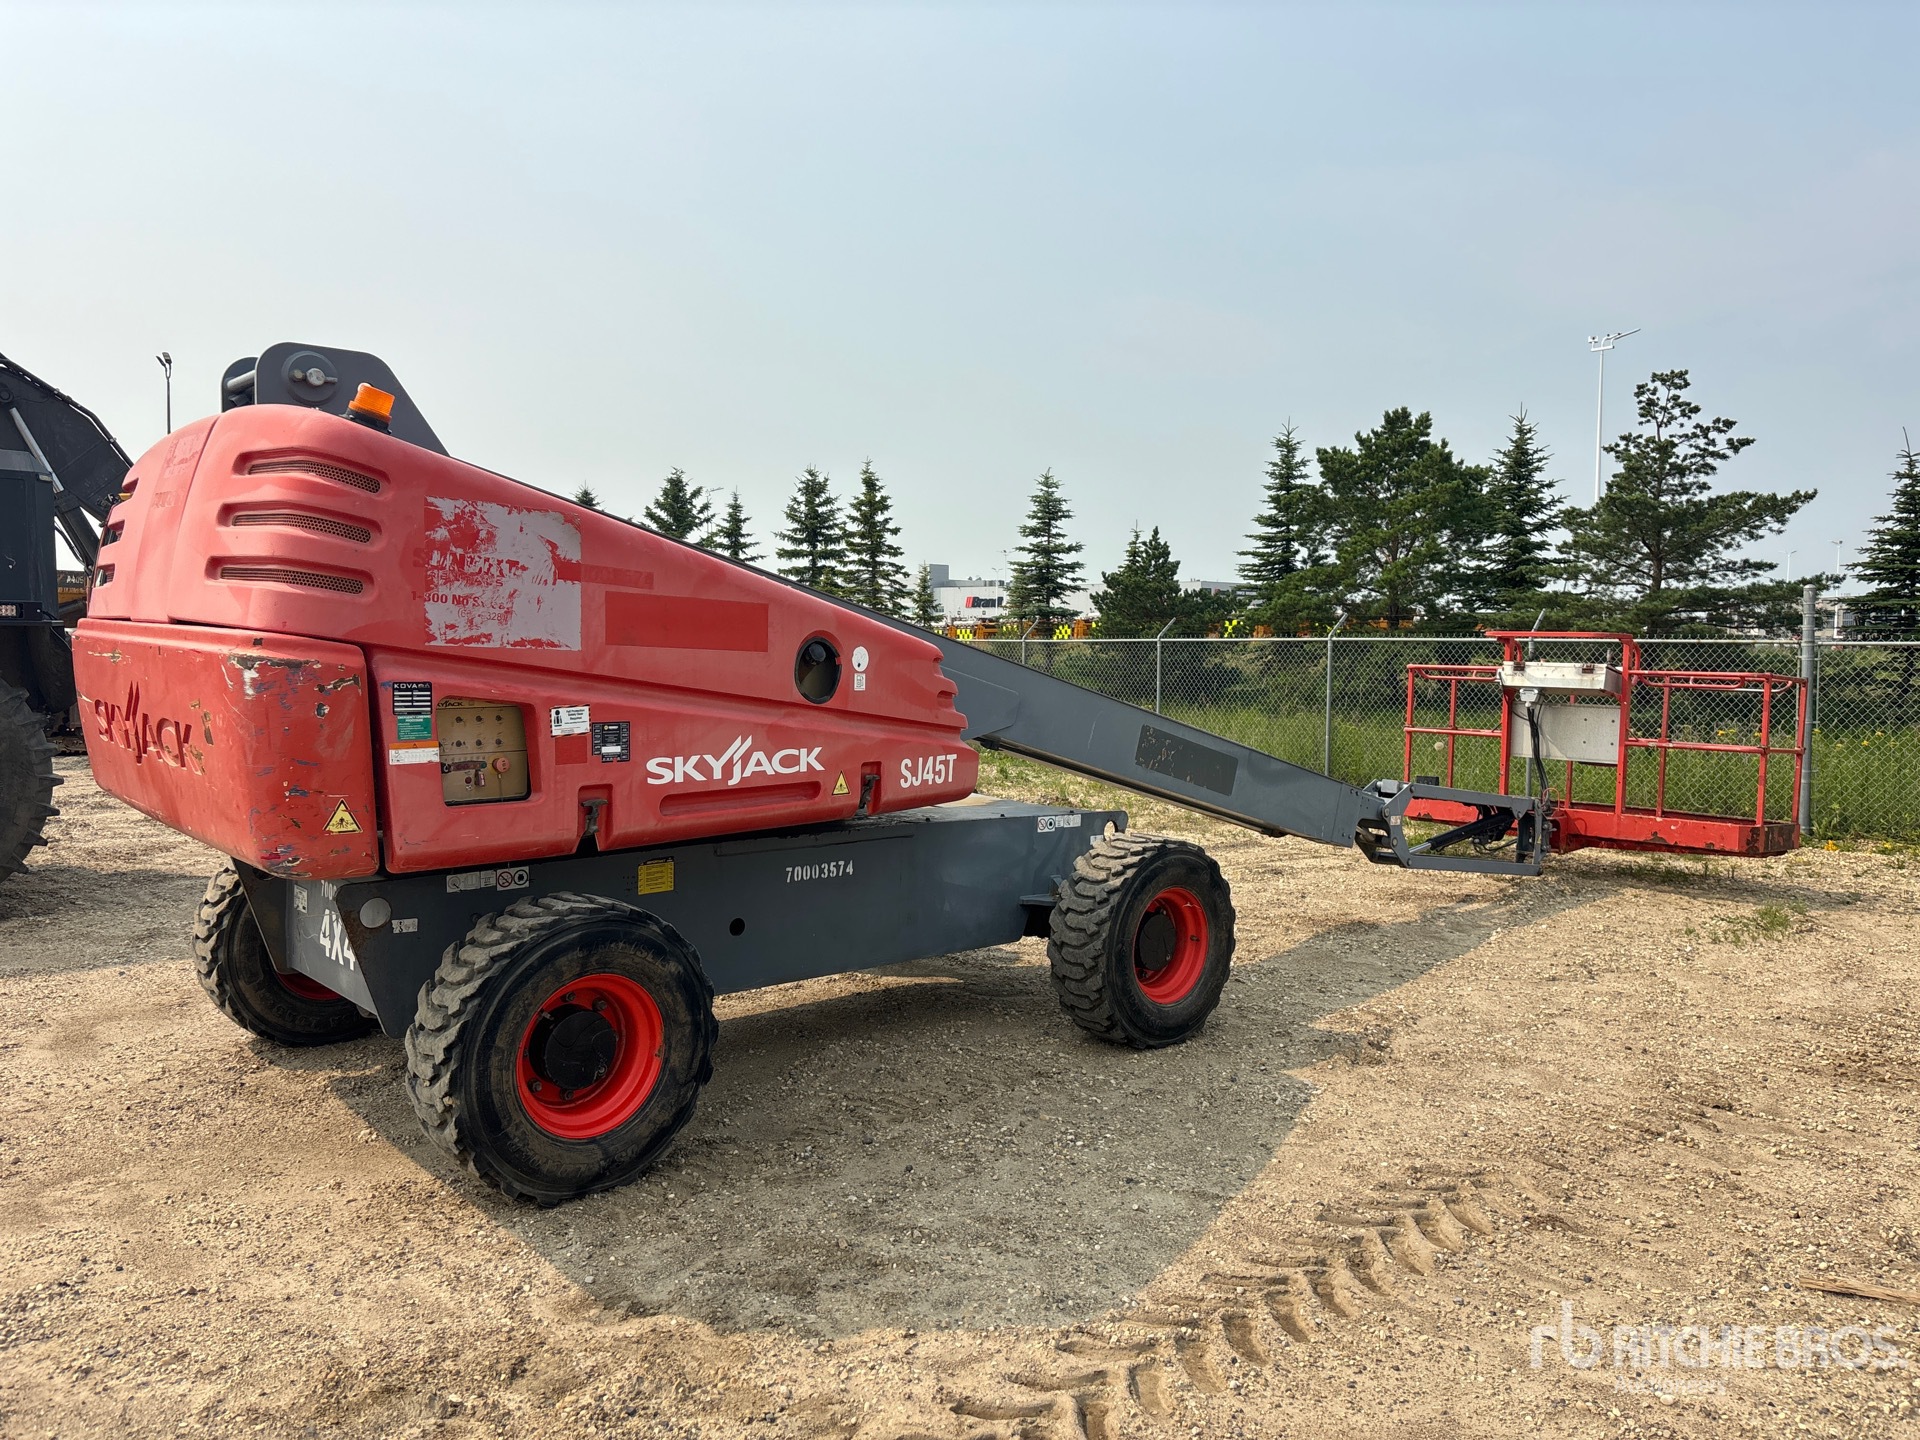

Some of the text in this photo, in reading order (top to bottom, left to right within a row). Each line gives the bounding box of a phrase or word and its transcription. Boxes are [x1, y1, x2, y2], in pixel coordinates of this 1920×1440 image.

[972, 596, 1004, 608] Brandt
[95, 681, 203, 775] SKYJACK
[646, 735, 825, 785] SKYJACK
[899, 753, 958, 790] SJ45T
[785, 859, 854, 883] 70003574
[319, 908, 356, 972] 4X4
